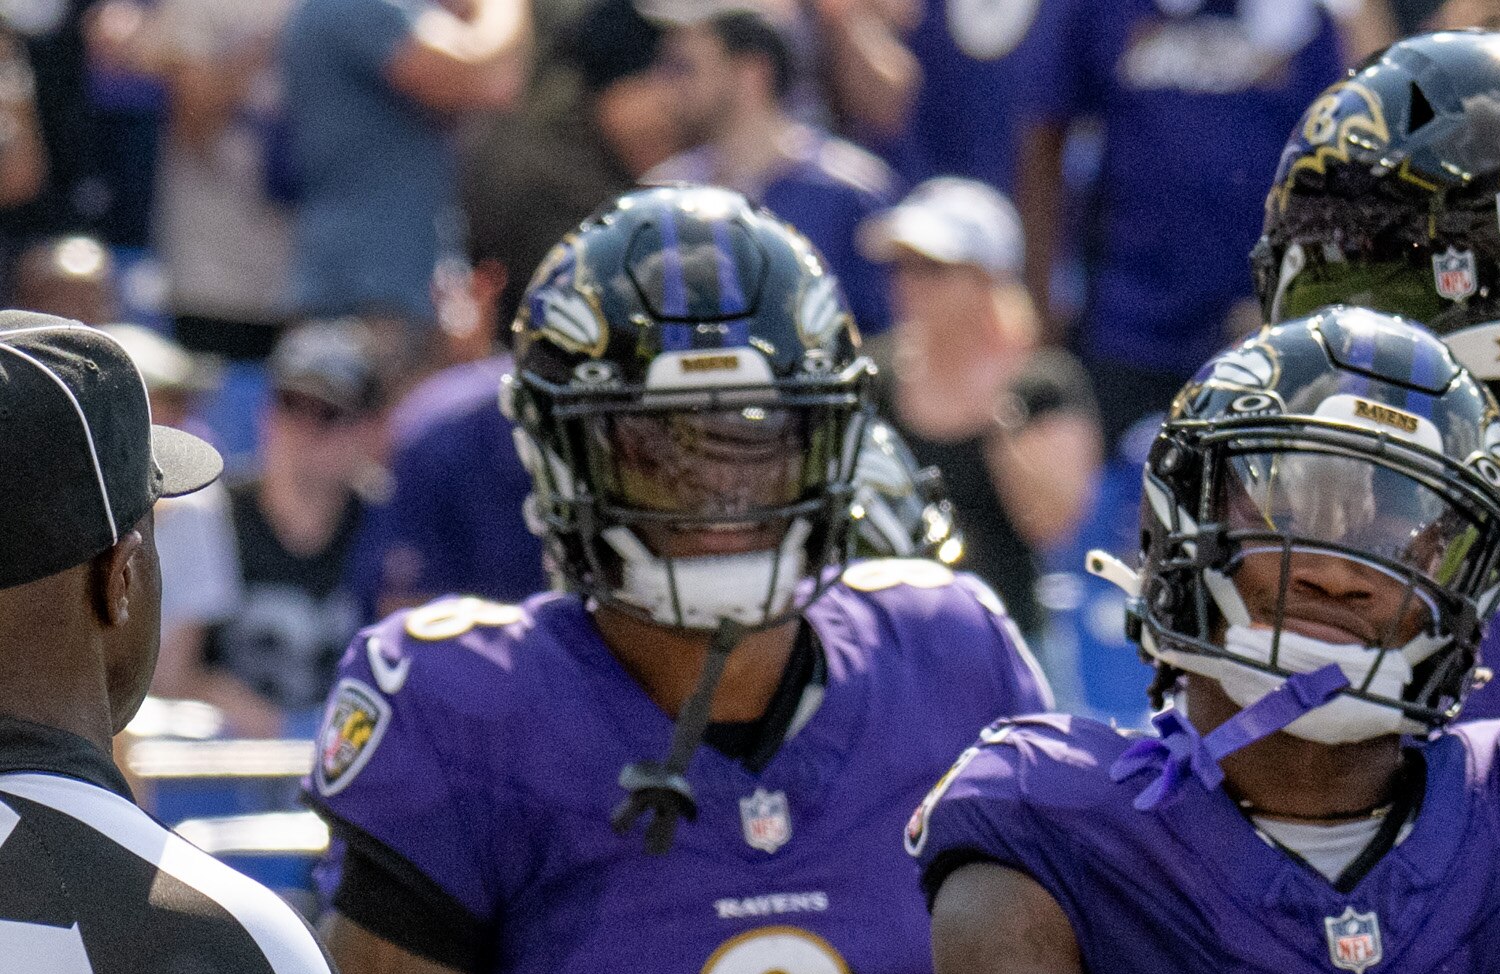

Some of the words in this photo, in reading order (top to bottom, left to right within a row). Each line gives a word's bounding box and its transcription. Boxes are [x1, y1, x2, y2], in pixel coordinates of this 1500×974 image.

[1354, 399, 1419, 434] RAVENS
[712, 891, 829, 919] RAVENS
[1337, 934, 1375, 961] NFL
